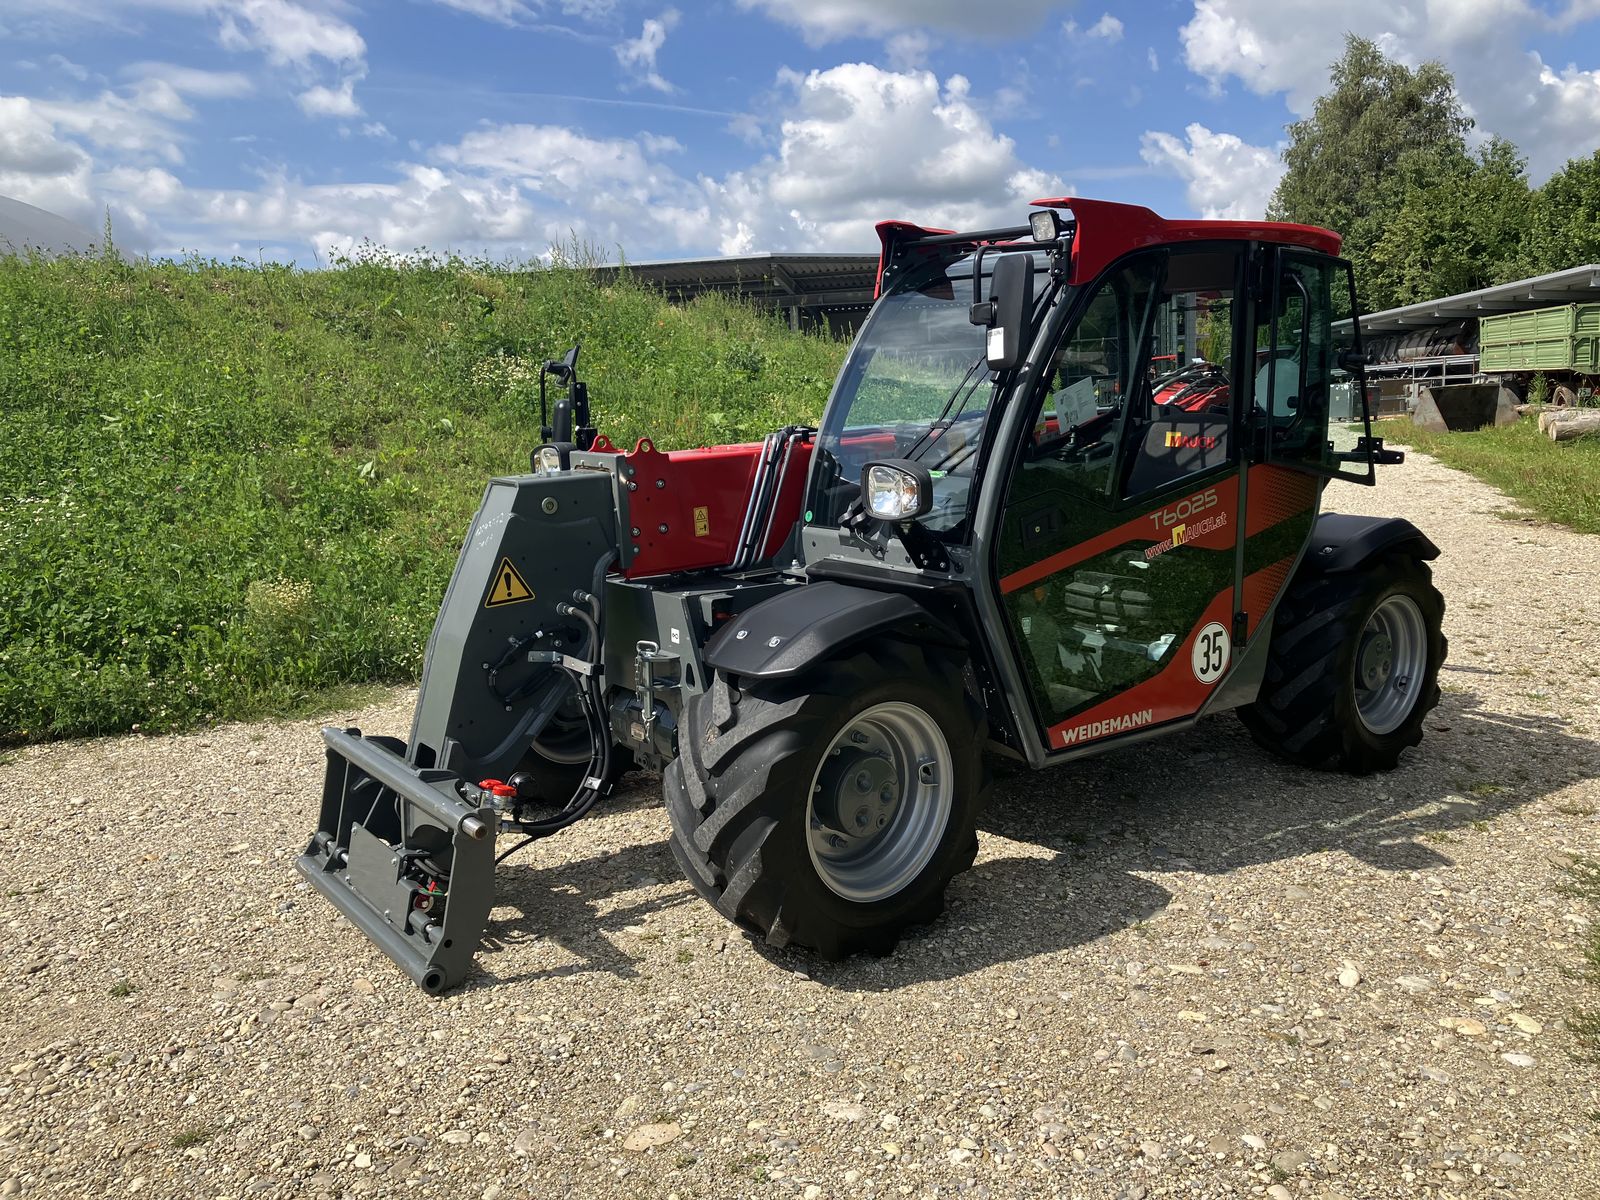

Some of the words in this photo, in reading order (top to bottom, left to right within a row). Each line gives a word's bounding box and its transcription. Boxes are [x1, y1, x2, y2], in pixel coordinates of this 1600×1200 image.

[1170, 435, 1215, 448] MAUCH
[1149, 488, 1218, 530] T6025
[1144, 511, 1227, 560] www.MAUCH.at
[1200, 630, 1223, 675] 35
[1061, 708, 1153, 744] WEIDEMANN
